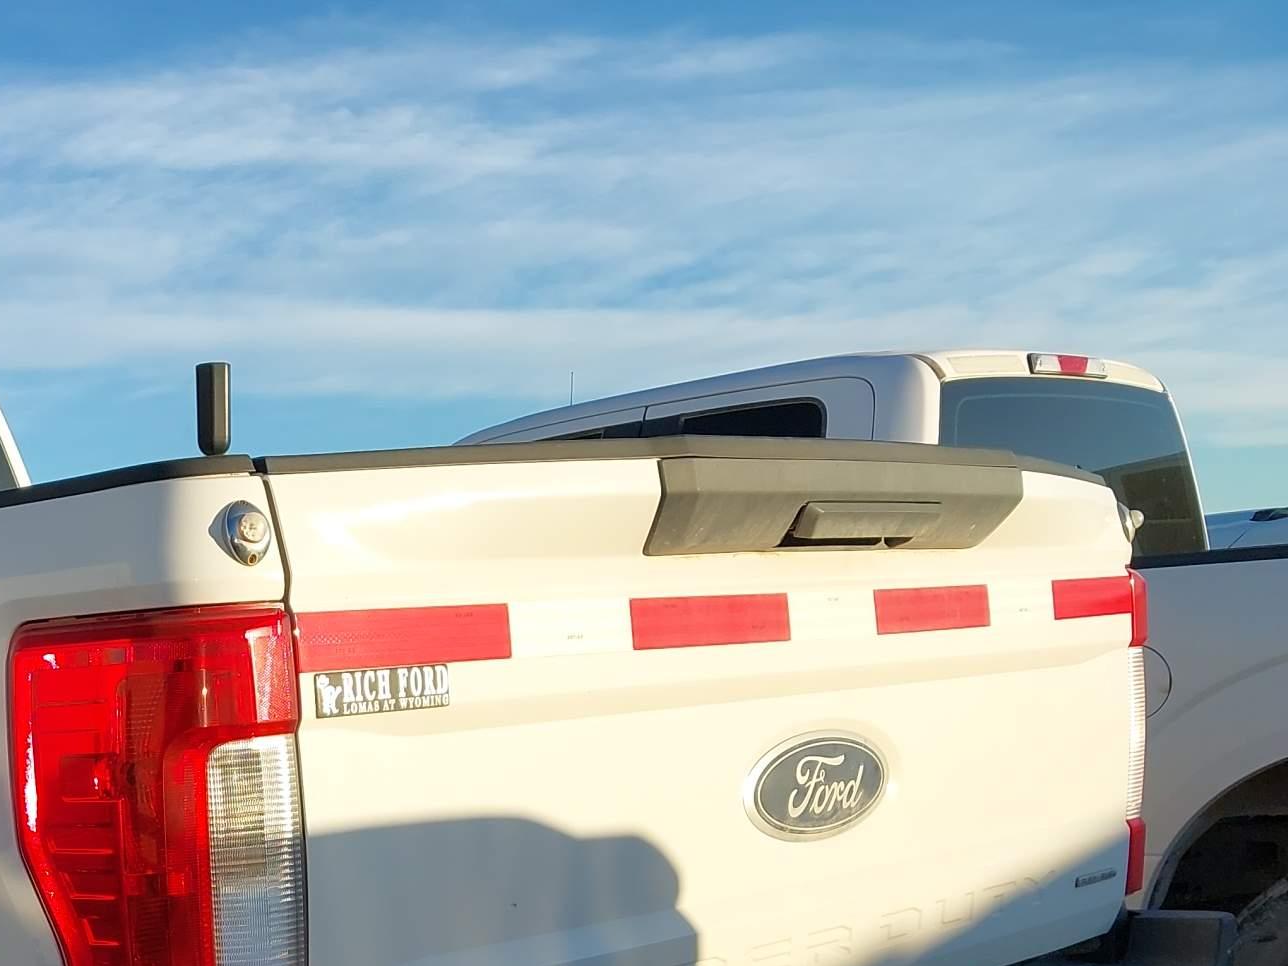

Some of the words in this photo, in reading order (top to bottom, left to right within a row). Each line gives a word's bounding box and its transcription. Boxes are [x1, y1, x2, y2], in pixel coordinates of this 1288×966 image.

[341, 671, 392, 702] RICH
[397, 665, 449, 697] FORD
[343, 700, 380, 714] LOMAS
[382, 698, 396, 711] AT
[399, 693, 449, 708] WYOMING
[788, 754, 865, 818] Ford
[878, 868, 1059, 940] DUTY
